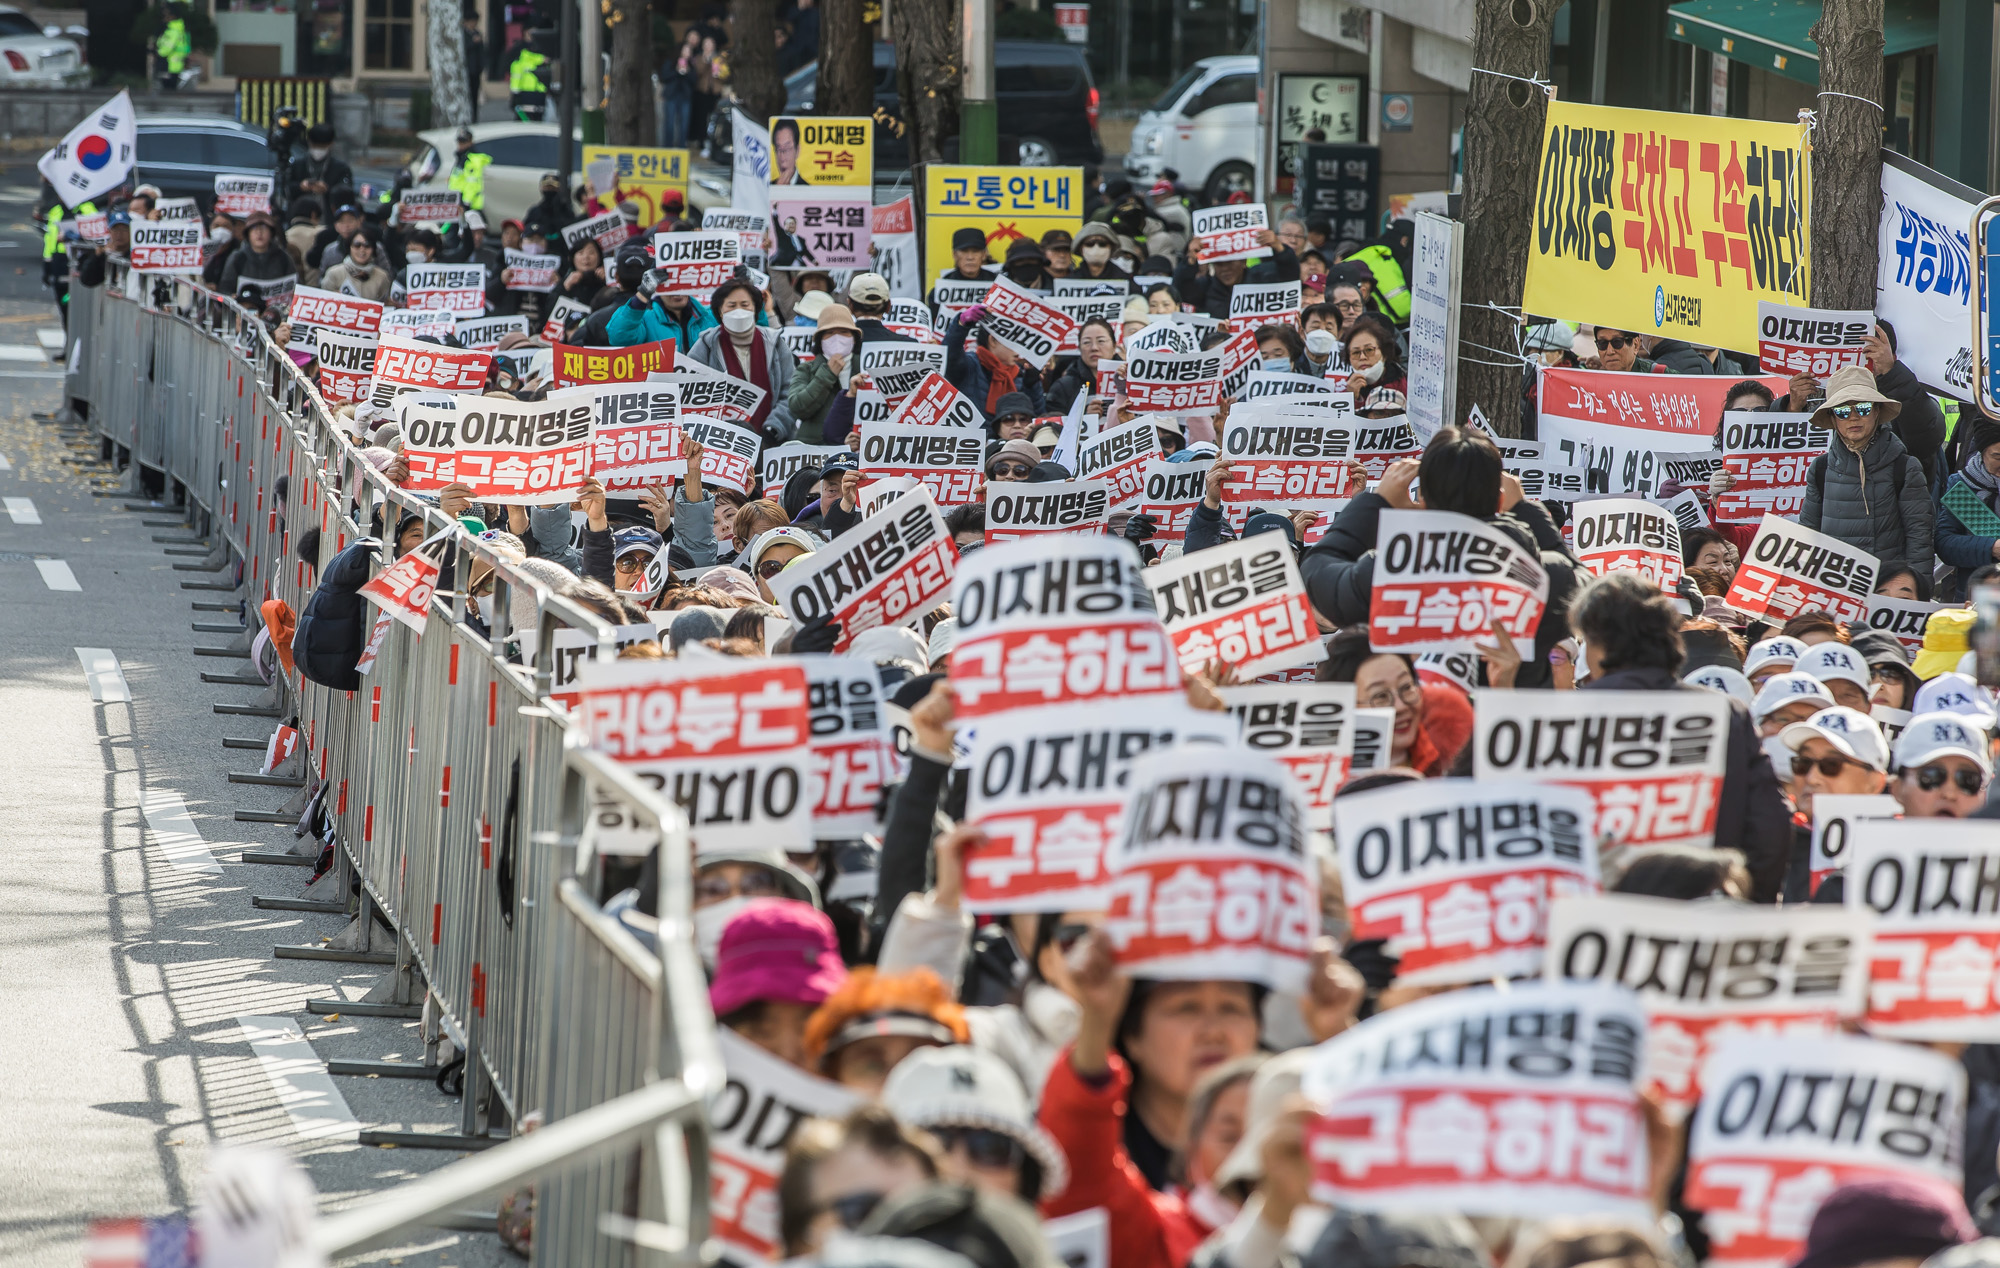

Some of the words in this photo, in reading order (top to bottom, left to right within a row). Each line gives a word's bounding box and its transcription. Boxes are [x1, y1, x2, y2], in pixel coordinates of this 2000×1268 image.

[804, 126, 864, 145] 이재명
[813, 151, 855, 171] 구속
[218, 176, 269, 195] 이재명을
[403, 193, 459, 206] 이재명을
[940, 176, 1070, 210] 교통안내
[1538, 125, 1616, 270] 이재명
[1621, 131, 1698, 278] 닥치고
[568, 212, 622, 243] 이재명을
[703, 214, 765, 231] 이재명을
[803, 207, 864, 227] 윤석열
[1197, 210, 1264, 233] 이재명을
[135, 229, 198, 245] 이재명을
[660, 239, 737, 261] 이재명을
[813, 232, 854, 252] 지지
[132, 248, 202, 267] 구속하라
[411, 271, 482, 289] 이재명을
[292, 297, 380, 329] 구속하라
[408, 290, 484, 311] 구속하라
[985, 288, 1069, 338] 구속하라
[1232, 289, 1299, 312] 이재명을
[1666, 294, 1701, 328] 신자유연대
[1762, 315, 1868, 346] 이재명을
[320, 342, 377, 372] 이재명
[377, 348, 488, 387] 구속하라
[563, 352, 634, 381] 재명아
[1130, 357, 1220, 382] 이재명을
[322, 371, 372, 401] 구속하
[1128, 382, 1222, 409] 구속하라
[595, 392, 676, 425] 재명을
[1568, 386, 1607, 417] 그래도
[1608, 390, 1646, 423] 정의는
[1649, 393, 1700, 431] 살아있었다
[461, 406, 591, 447] 이재명을
[683, 423, 757, 459] 재명을
[1227, 427, 1350, 457] 이재명을
[1726, 421, 1831, 450] 이재명을
[595, 427, 682, 465] 속하라
[864, 434, 981, 467] 이재명을
[456, 446, 596, 491] 구속하라
[700, 453, 751, 487] 하라
[1229, 464, 1350, 496] 구속하라
[991, 489, 1106, 525] 이재명을
[1578, 513, 1680, 551] 이재명을
[791, 504, 936, 624] 이재명을
[1385, 531, 1542, 590] 이재명을
[1755, 533, 1874, 599] 이재명을
[1158, 550, 1287, 624] 재명을
[1374, 585, 1539, 636] 구속하라
[1178, 597, 1309, 672] 속하라
[953, 629, 1180, 704] 구속하라
[1823, 652, 1854, 671] NA
[1488, 714, 1716, 770] 이재명을
[982, 731, 1185, 798] 이재명
[1600, 779, 1717, 844] 하라
[969, 812, 1115, 888] 구속
[1355, 802, 1583, 880] 이재명을
[1865, 855, 2000, 915] 이재
[1563, 930, 1852, 1000] 이재명을
[1312, 1093, 1648, 1178] 구속하라
